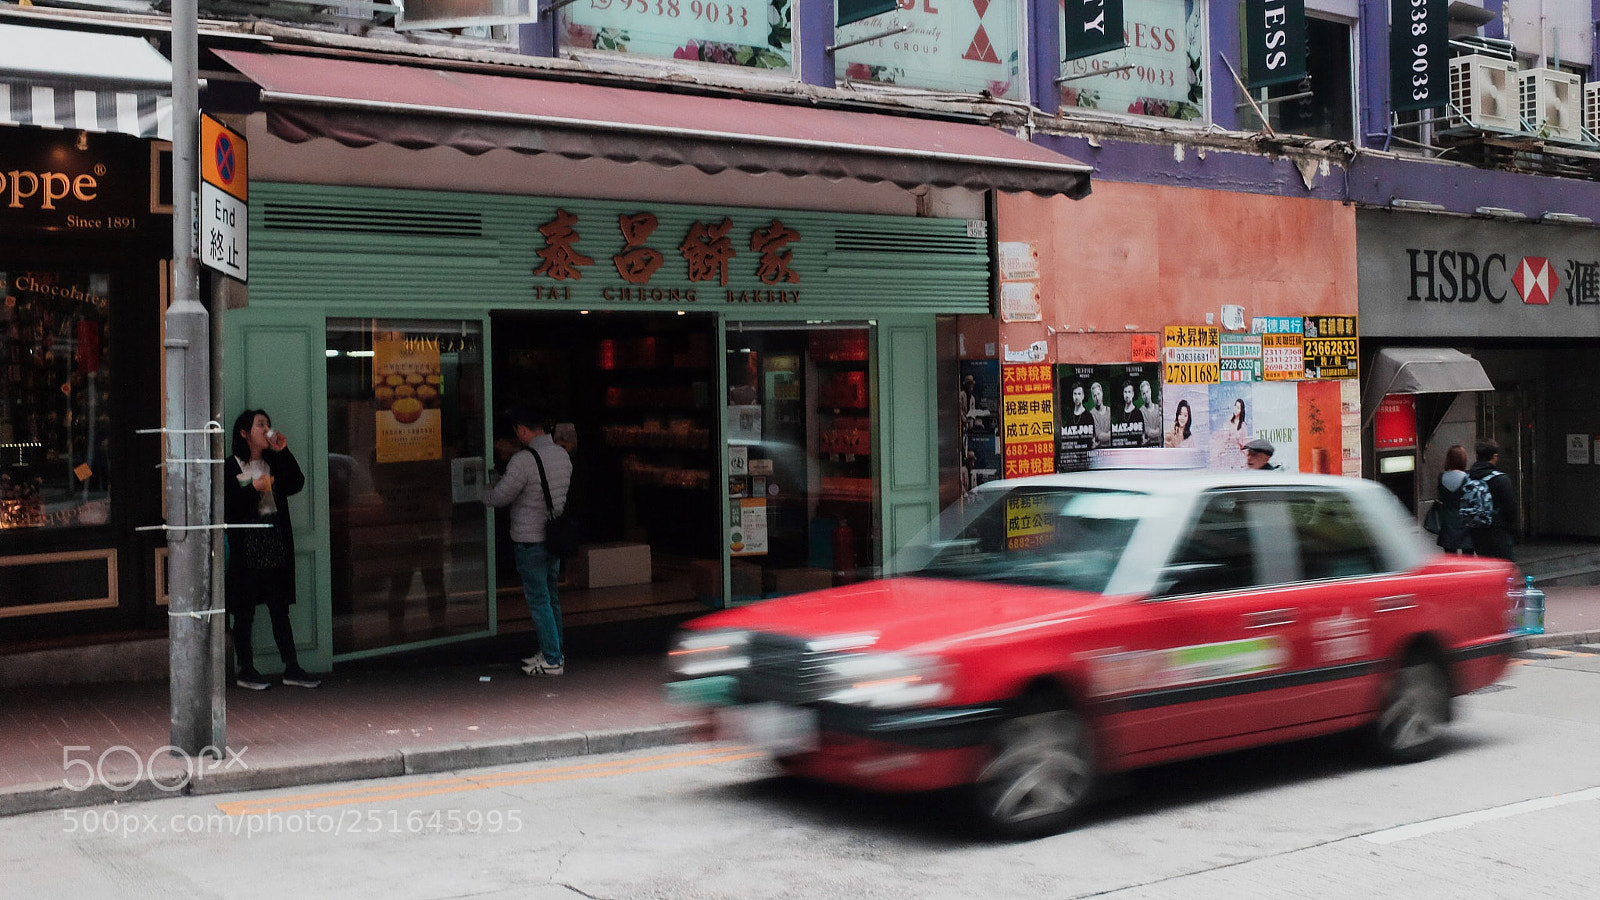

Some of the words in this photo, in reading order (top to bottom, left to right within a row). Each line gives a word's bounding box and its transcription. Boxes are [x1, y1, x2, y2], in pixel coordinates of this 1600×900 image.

[691, 0, 748, 27] 9033
[893, 41, 939, 55] GROUP
[1136, 65, 1175, 87] 9033
[1411, 43, 1429, 101] 9033
[66, 214, 101, 228] Since
[107, 216, 136, 229] 1891
[215, 198, 236, 228] End
[210, 227, 240, 270] 終止
[532, 207, 802, 287] 泰昌餅家
[1406, 249, 1508, 304] HSBC
[16, 275, 108, 307] Chocolates
[533, 286, 571, 300] TAI
[603, 287, 698, 302] CHEONG
[726, 290, 801, 303] BAKERY
[1305, 340, 1356, 356] 23662833
[1167, 364, 1219, 383] 27811682
[1006, 421, 1053, 438] 成立公司
[1006, 442, 1054, 456] 6882-1888
